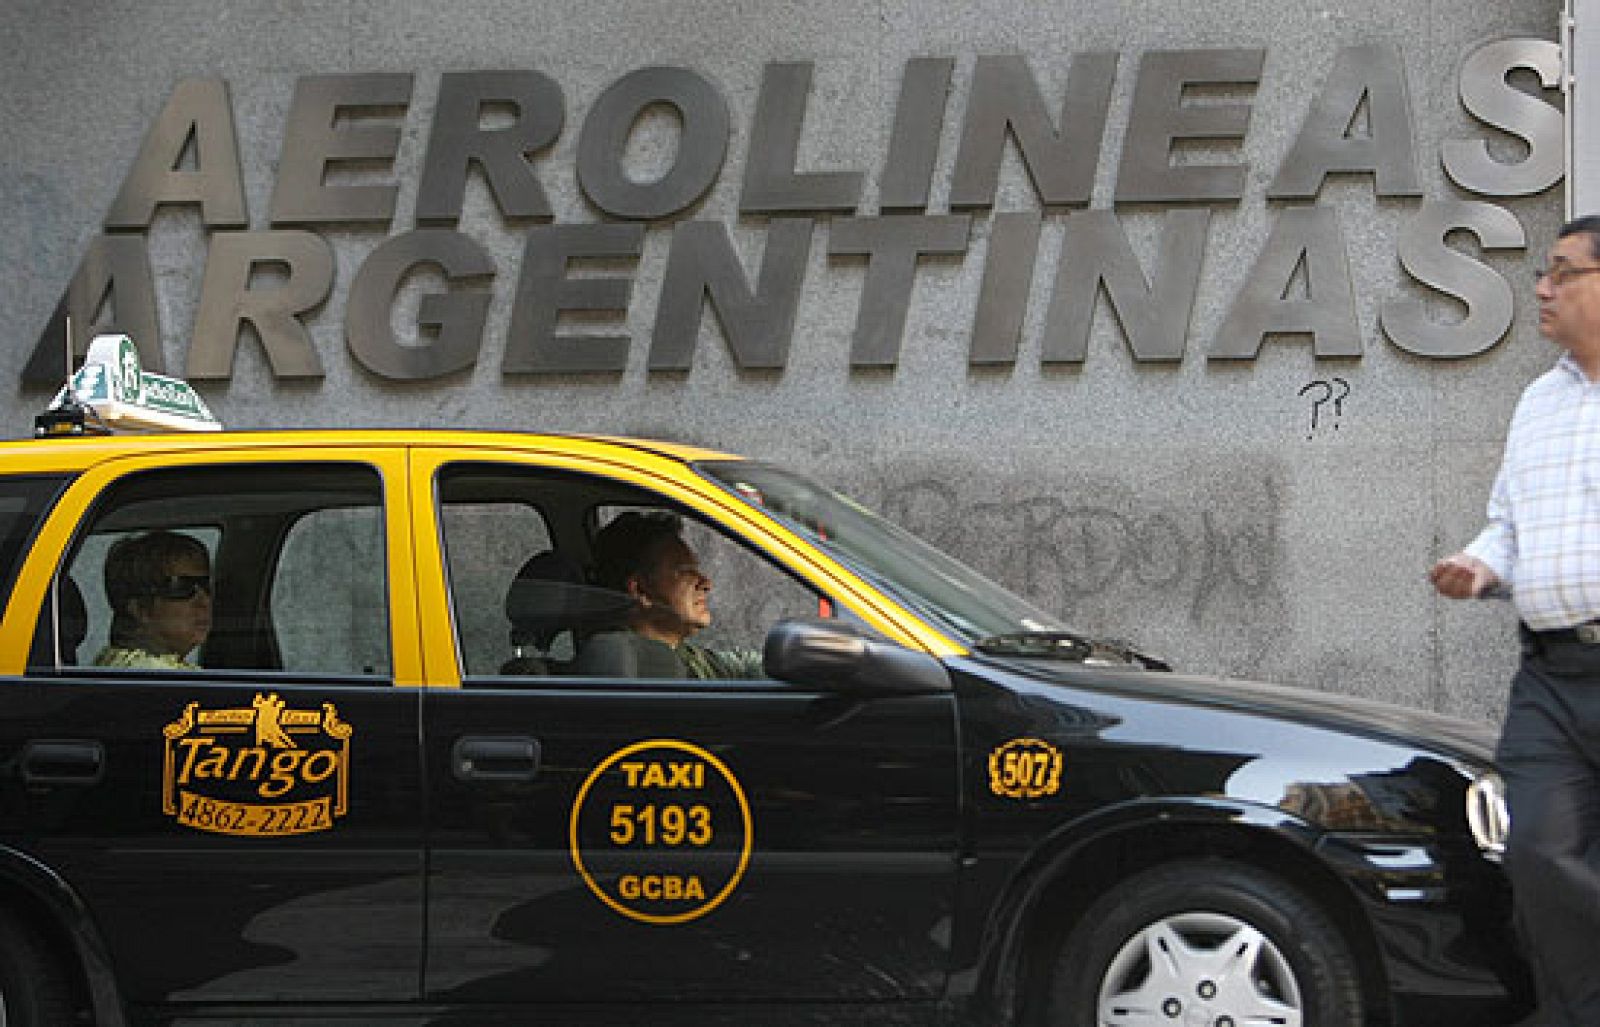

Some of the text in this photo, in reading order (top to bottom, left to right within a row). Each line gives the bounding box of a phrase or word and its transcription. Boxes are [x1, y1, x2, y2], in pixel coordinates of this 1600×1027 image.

[104, 37, 1565, 230] AEROLINEAS
[20, 199, 1526, 388] ARGENTINAS
[178, 737, 339, 797] Tango
[620, 761, 705, 788] TAXI
[1003, 753, 1049, 787] 507
[609, 804, 713, 846] 5193
[618, 875, 706, 901] GCBA
